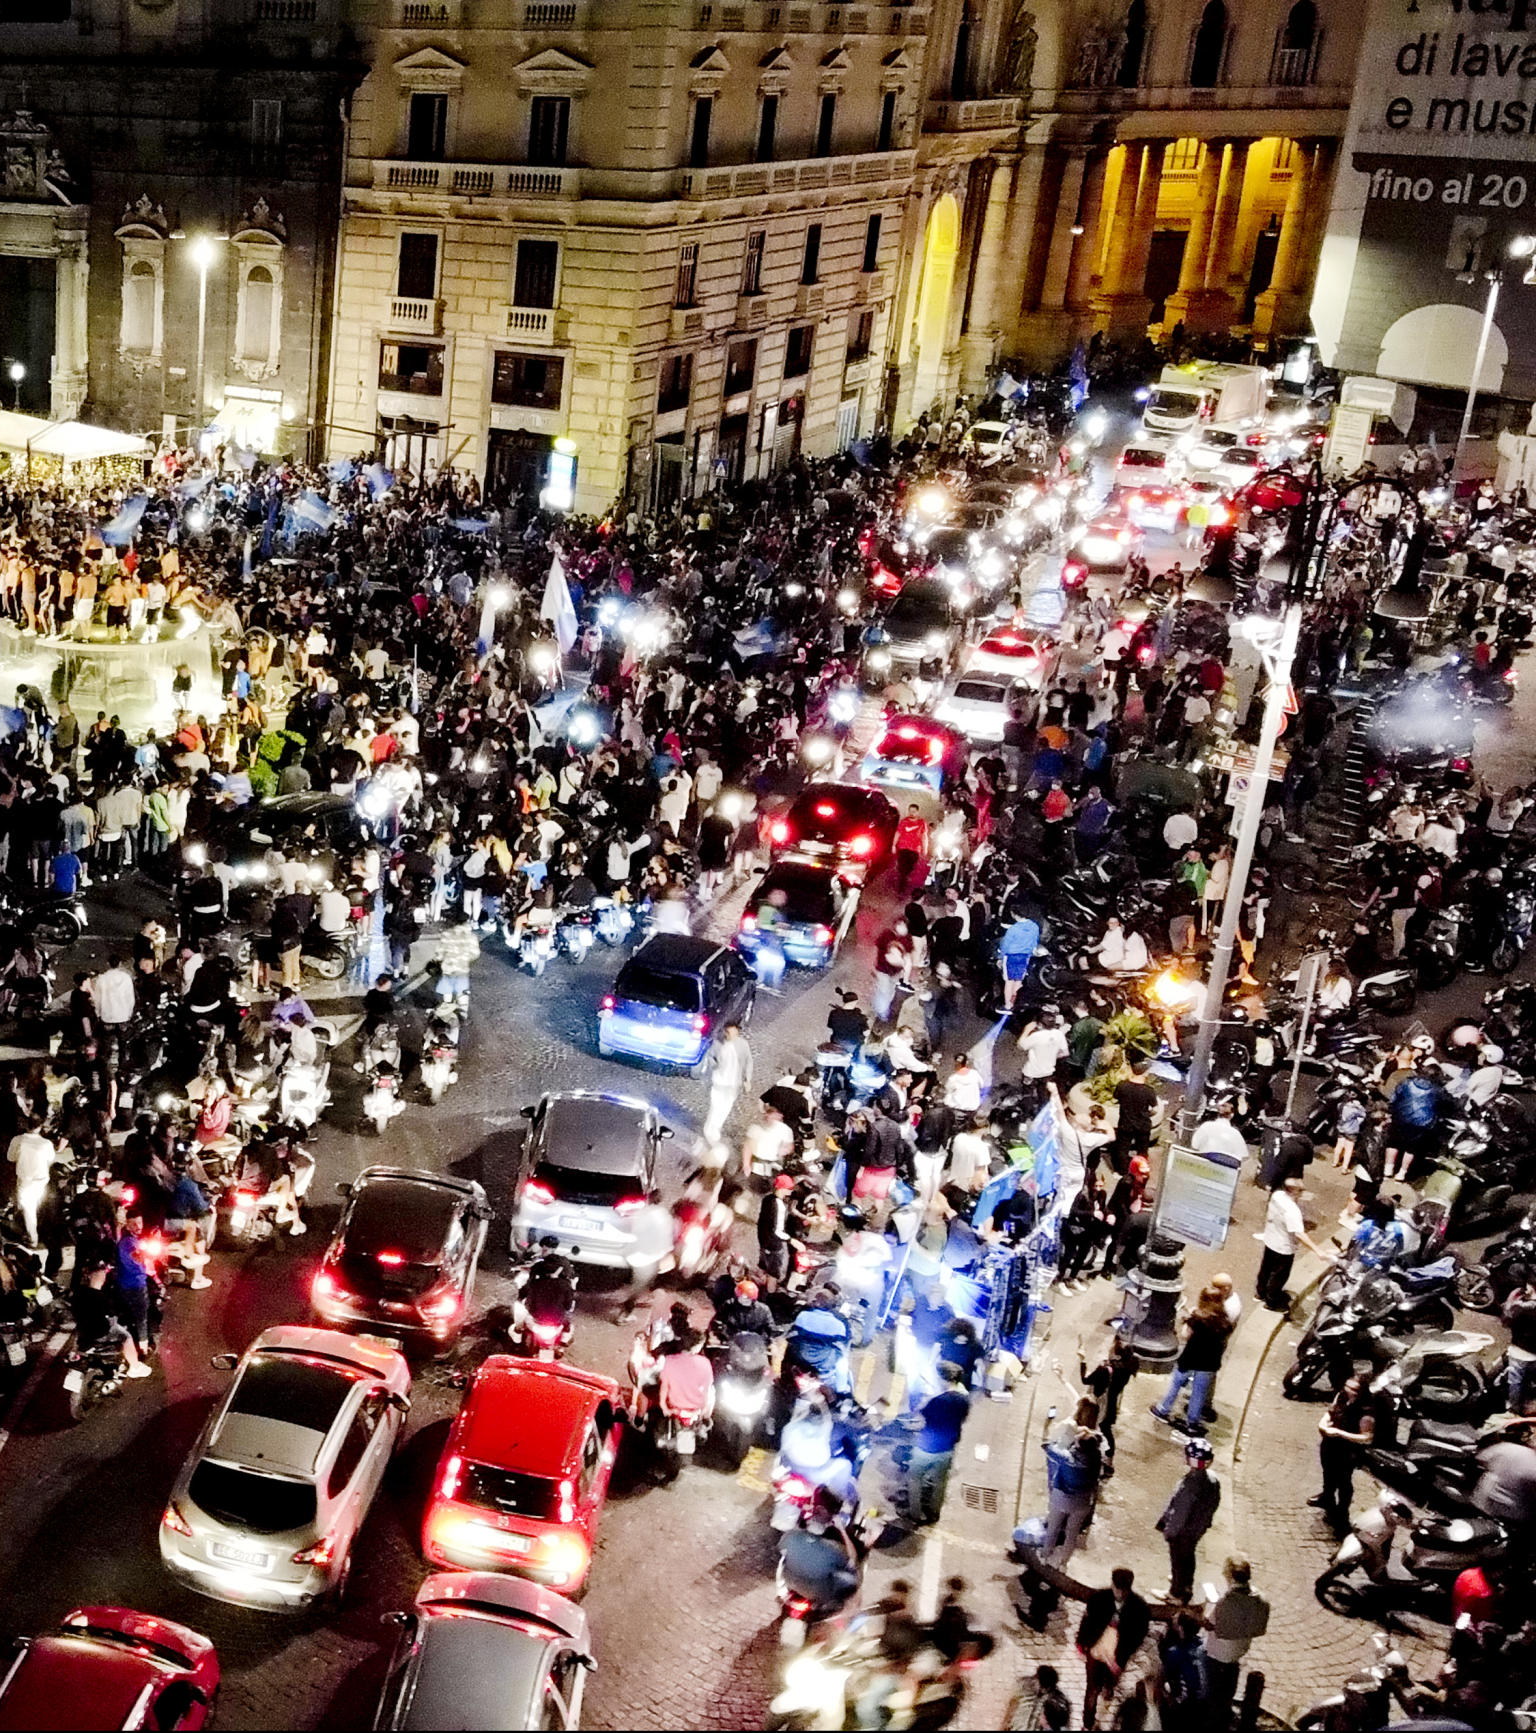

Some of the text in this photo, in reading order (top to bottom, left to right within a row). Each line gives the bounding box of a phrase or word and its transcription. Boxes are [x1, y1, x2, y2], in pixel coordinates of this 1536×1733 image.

[1396, 33, 1439, 76] di
[1386, 97, 1413, 129] e
[1371, 168, 1527, 208] fino al 20
